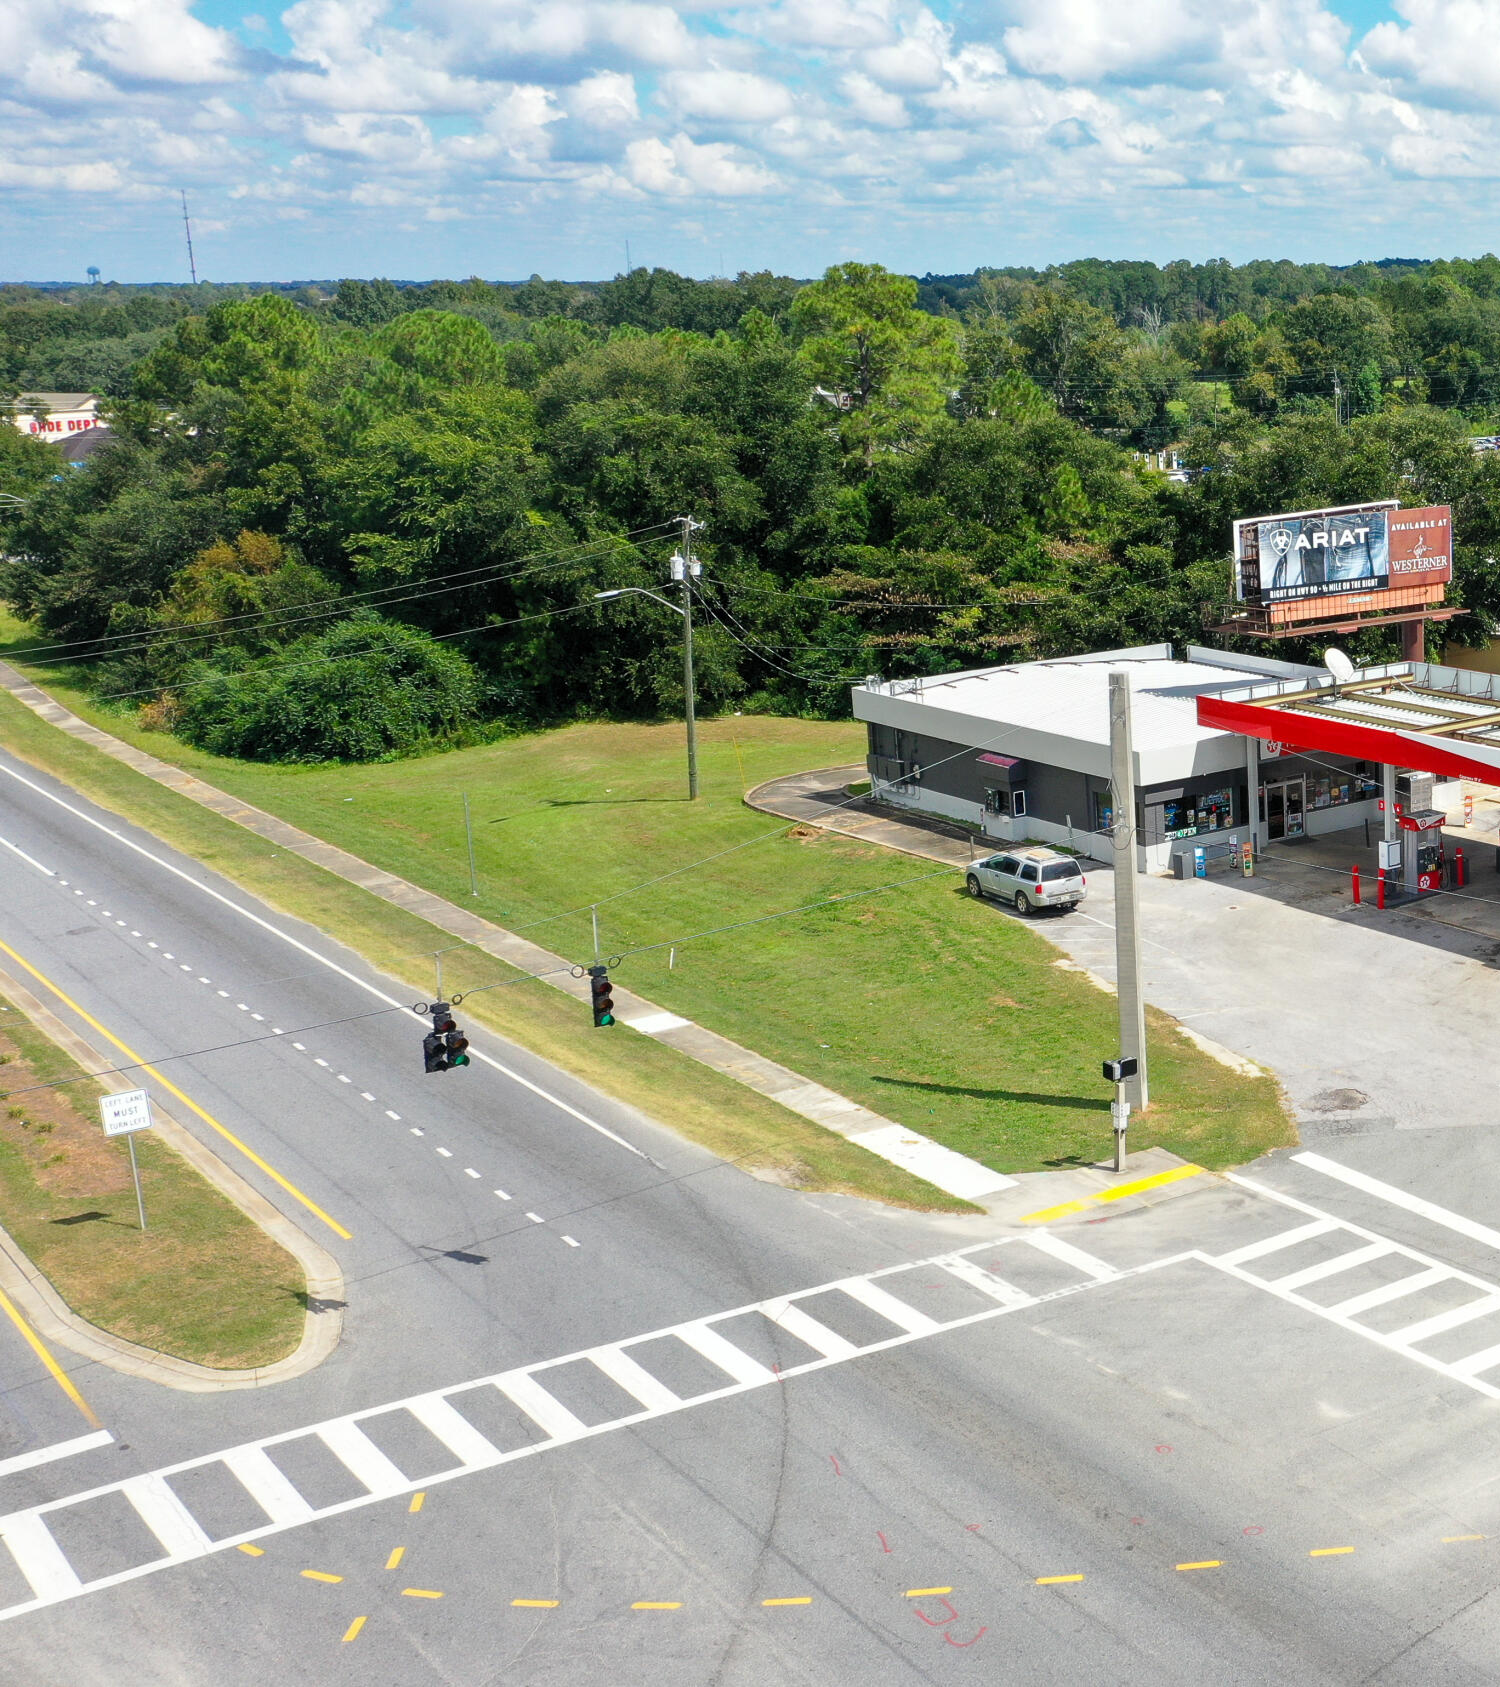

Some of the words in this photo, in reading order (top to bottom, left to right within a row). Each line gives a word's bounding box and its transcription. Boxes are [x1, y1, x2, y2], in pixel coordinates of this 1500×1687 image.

[29, 420, 62, 433] SHOE
[68, 418, 99, 431] DEPT
[1391, 520, 1435, 531] AVAILABLE
[1437, 519, 1447, 527] AT
[1294, 527, 1370, 550] ARIAT
[1391, 555, 1448, 571] WESTERNER
[1269, 589, 1287, 598] RIGHT
[1328, 582, 1342, 592] MILE
[1351, 580, 1361, 589] THE
[1361, 578, 1378, 588] RIGHT
[104, 1098, 121, 1108] LEFT
[125, 1094, 144, 1103] LANE
[113, 1106, 138, 1117] MUST
[109, 1121, 129, 1130] TURN
[129, 1117, 147, 1126] LEFT
